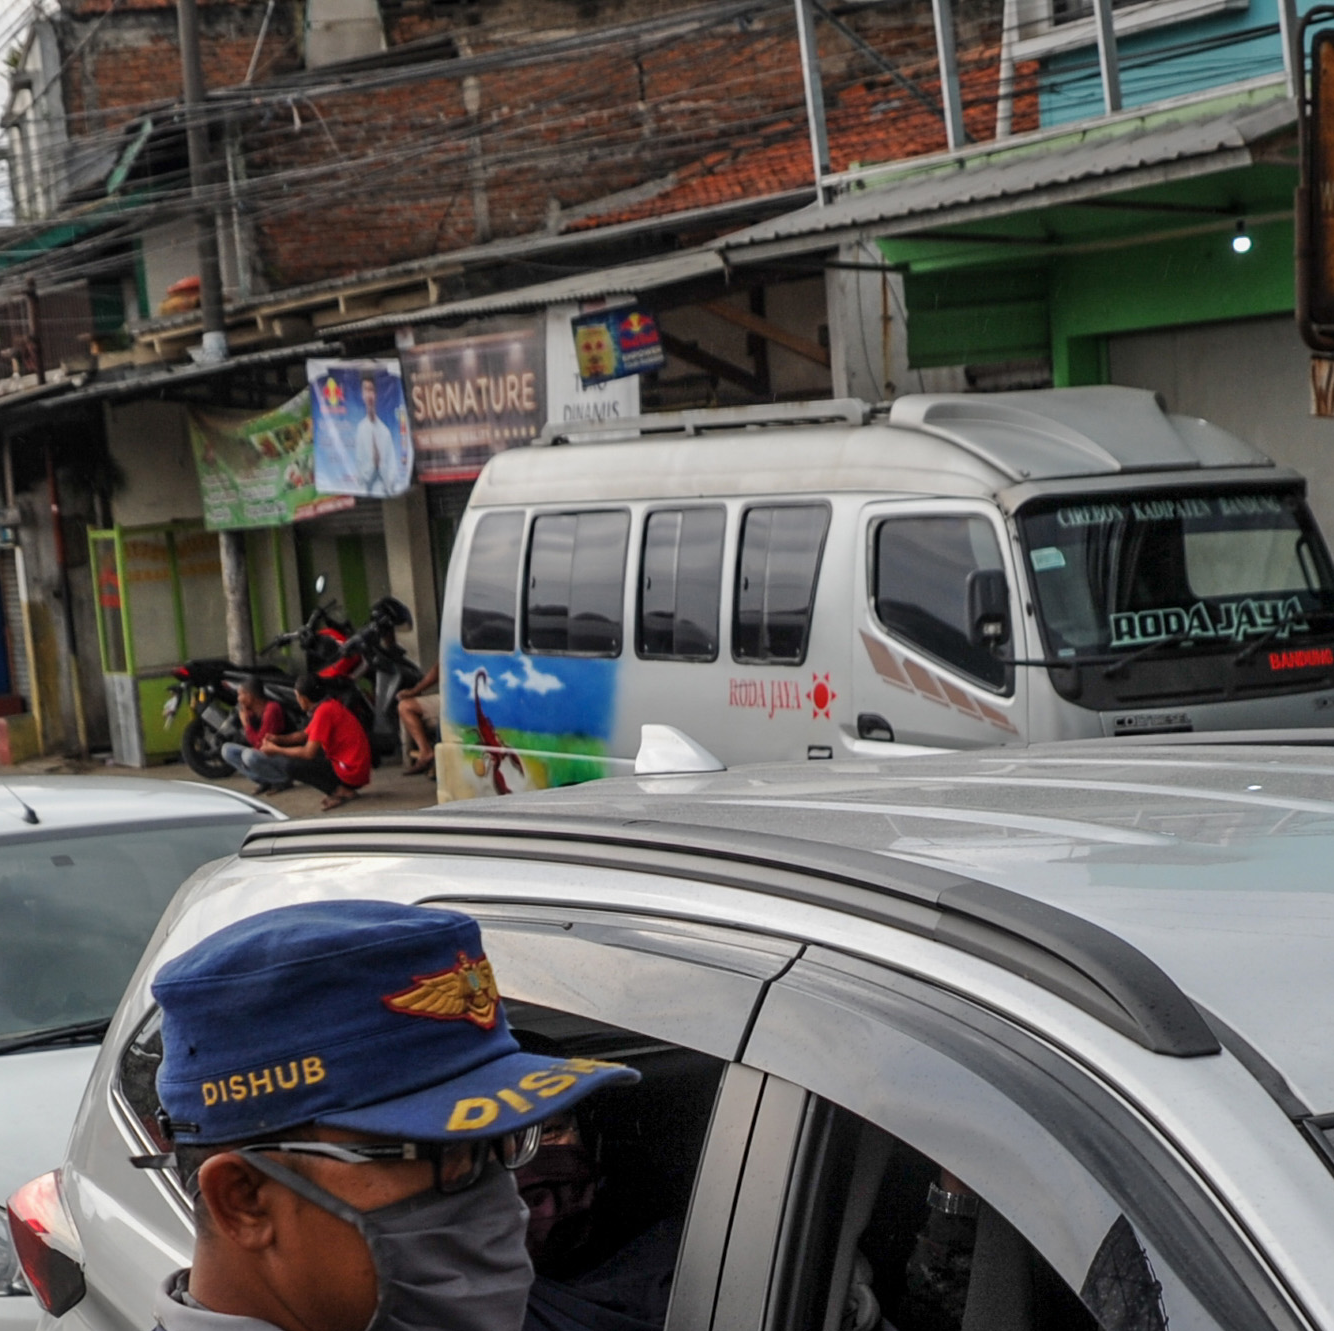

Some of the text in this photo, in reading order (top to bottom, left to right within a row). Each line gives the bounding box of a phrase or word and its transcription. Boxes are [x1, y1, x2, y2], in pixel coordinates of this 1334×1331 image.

[412, 372, 536, 421] SIGNATURE
[563, 401, 620, 423] DINAMIS
[1057, 505, 1123, 528] CIREBON
[1131, 501, 1212, 521] KADIPATEN
[1110, 596, 1310, 647] RODA JAYA
[1269, 648, 1334, 671] BANDUNG
[729, 678, 801, 720] RODA JAYA
[201, 1056, 327, 1107] DISHUB
